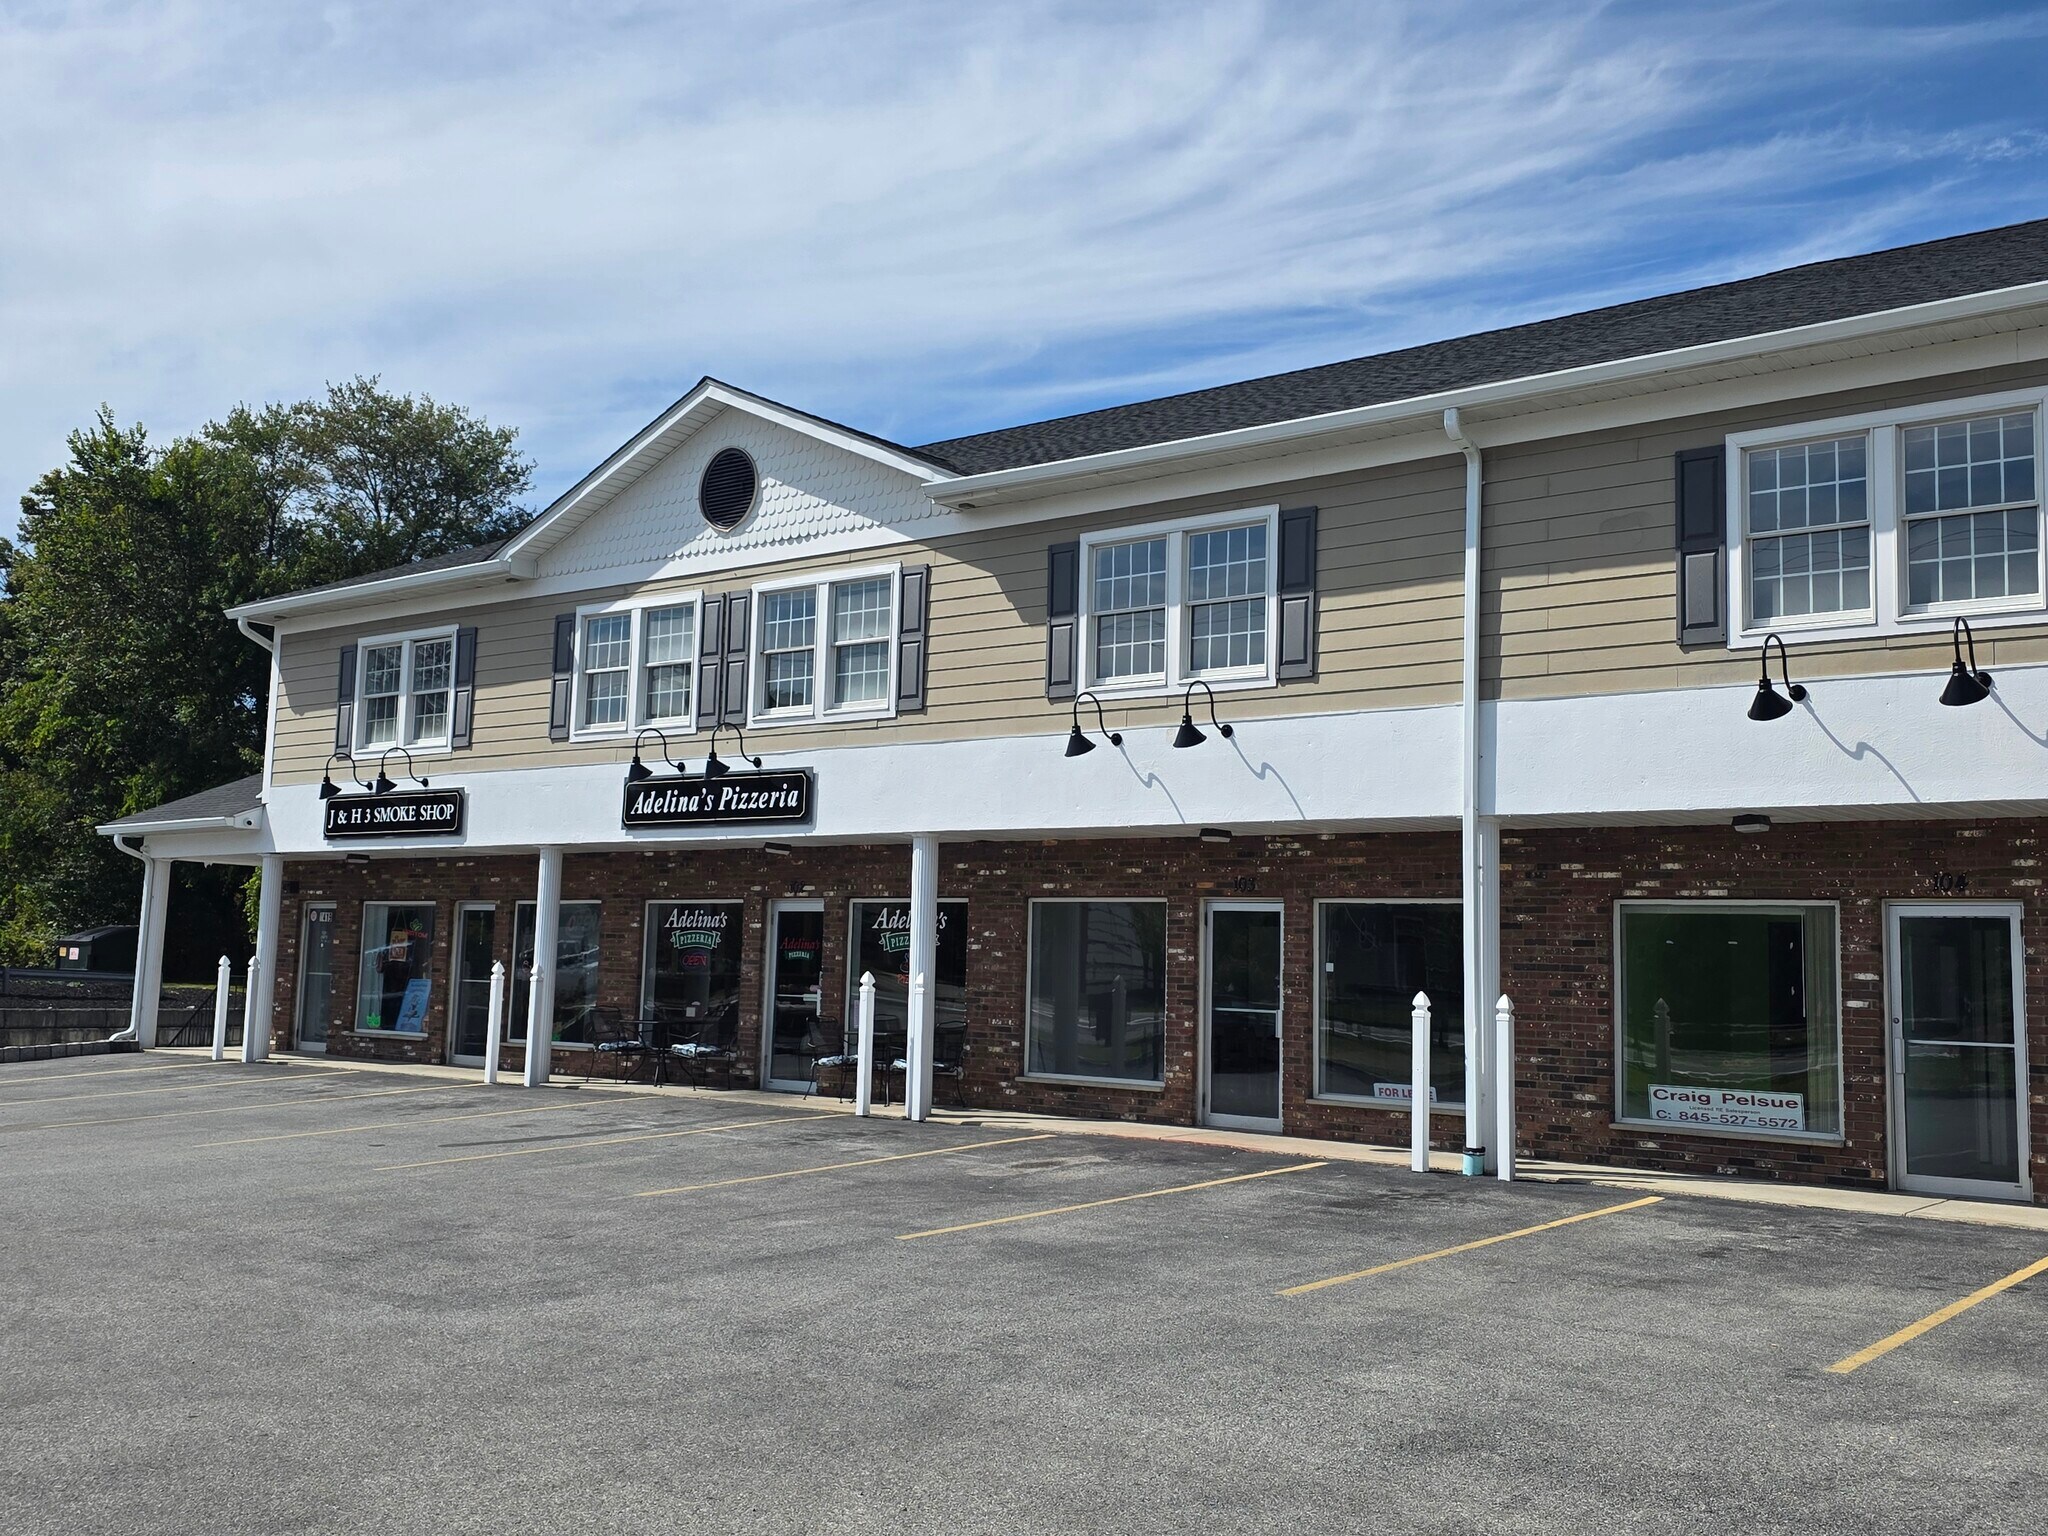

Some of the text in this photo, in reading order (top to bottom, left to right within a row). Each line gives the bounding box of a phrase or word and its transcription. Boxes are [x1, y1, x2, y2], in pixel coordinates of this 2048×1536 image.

[631, 783, 799, 815] Adelina's Pizzeria
[328, 804, 454, 828] J & H 3 SMOKE SHOP
[1935, 872, 1968, 891] 104
[664, 908, 728, 928] Adelina's
[872, 907, 947, 929] Adel's
[680, 933, 712, 945] PIZZERIA
[1378, 1087, 1399, 1098] FOR
[1653, 1088, 1799, 1109] Craig Pelsue
[1656, 1109, 1798, 1129] C: 845-527-5572
[1725, 1107, 1761, 1115] Salesperson
